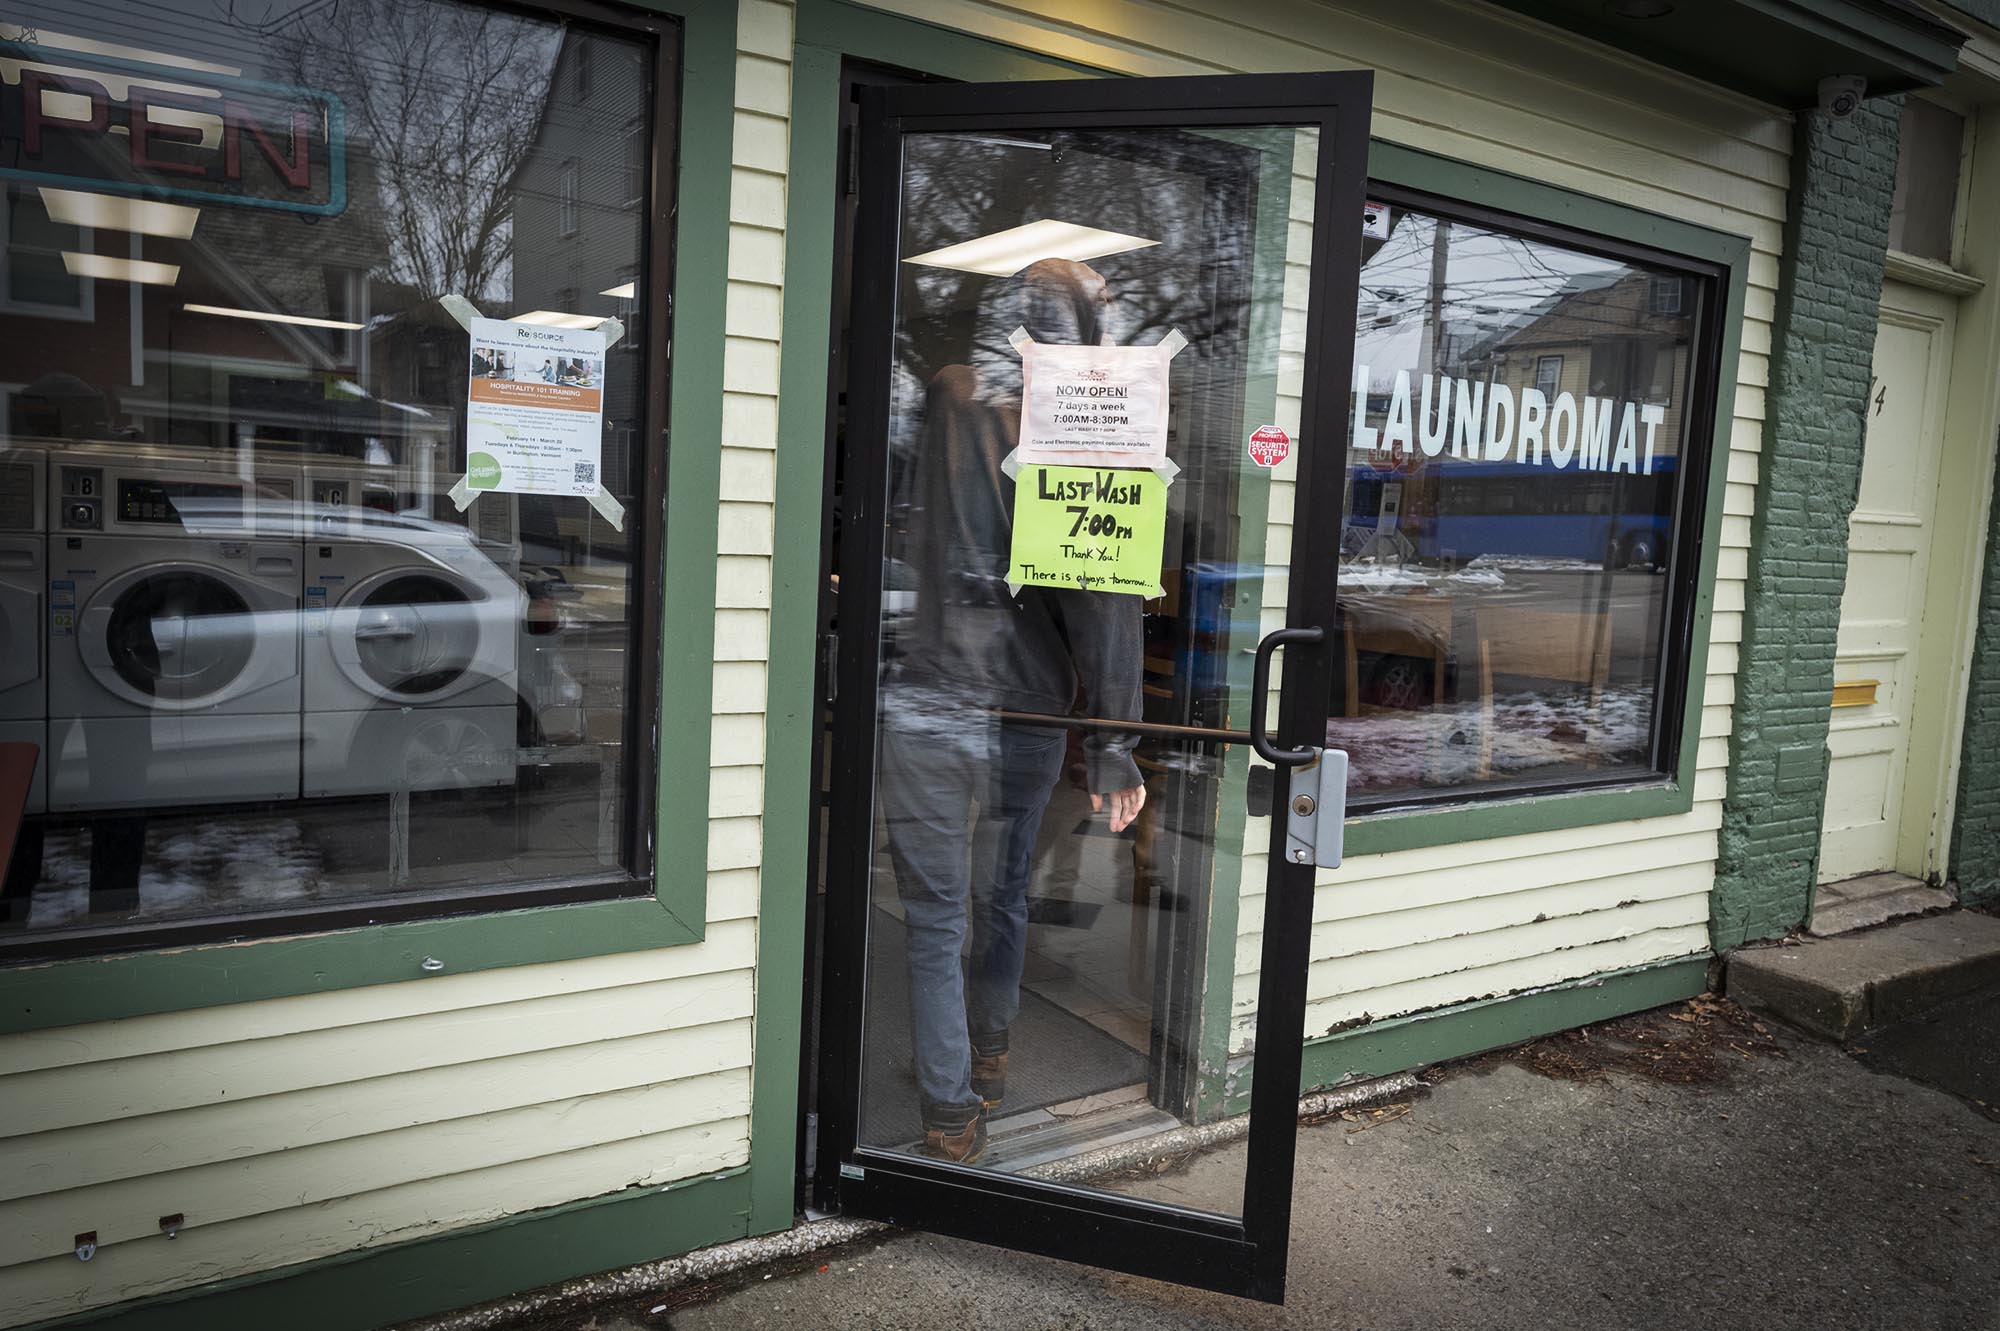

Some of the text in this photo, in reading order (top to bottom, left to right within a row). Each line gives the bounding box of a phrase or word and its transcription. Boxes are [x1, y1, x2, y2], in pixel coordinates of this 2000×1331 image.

[22, 68, 311, 190] PEN
[517, 329, 564, 342] Re SOURCE
[490, 382, 535, 393] HOSPITALITY
[549, 388, 581, 397] TRAINING
[1056, 385, 1128, 397] NOW OPEN!
[1057, 401, 1064, 410] 7
[1065, 401, 1089, 412] days
[1100, 402, 1126, 412] week
[1053, 414, 1129, 425] 7:00AM-8:30PM
[1352, 364, 1665, 476] LAUNDROMAT
[484, 440, 508, 448] Tuesdays
[506, 435, 529, 443] February
[1082, 440, 1104, 448] payment
[1251, 441, 1289, 450] SECURITY
[1251, 448, 1287, 457] SYSTEM
[81, 477, 93, 495] B
[1038, 468, 1142, 506] LAST WASH
[331, 490, 341, 505] C
[1060, 544, 1120, 562] Thank You!
[1020, 564, 1154, 588] There is always tomorrow...
